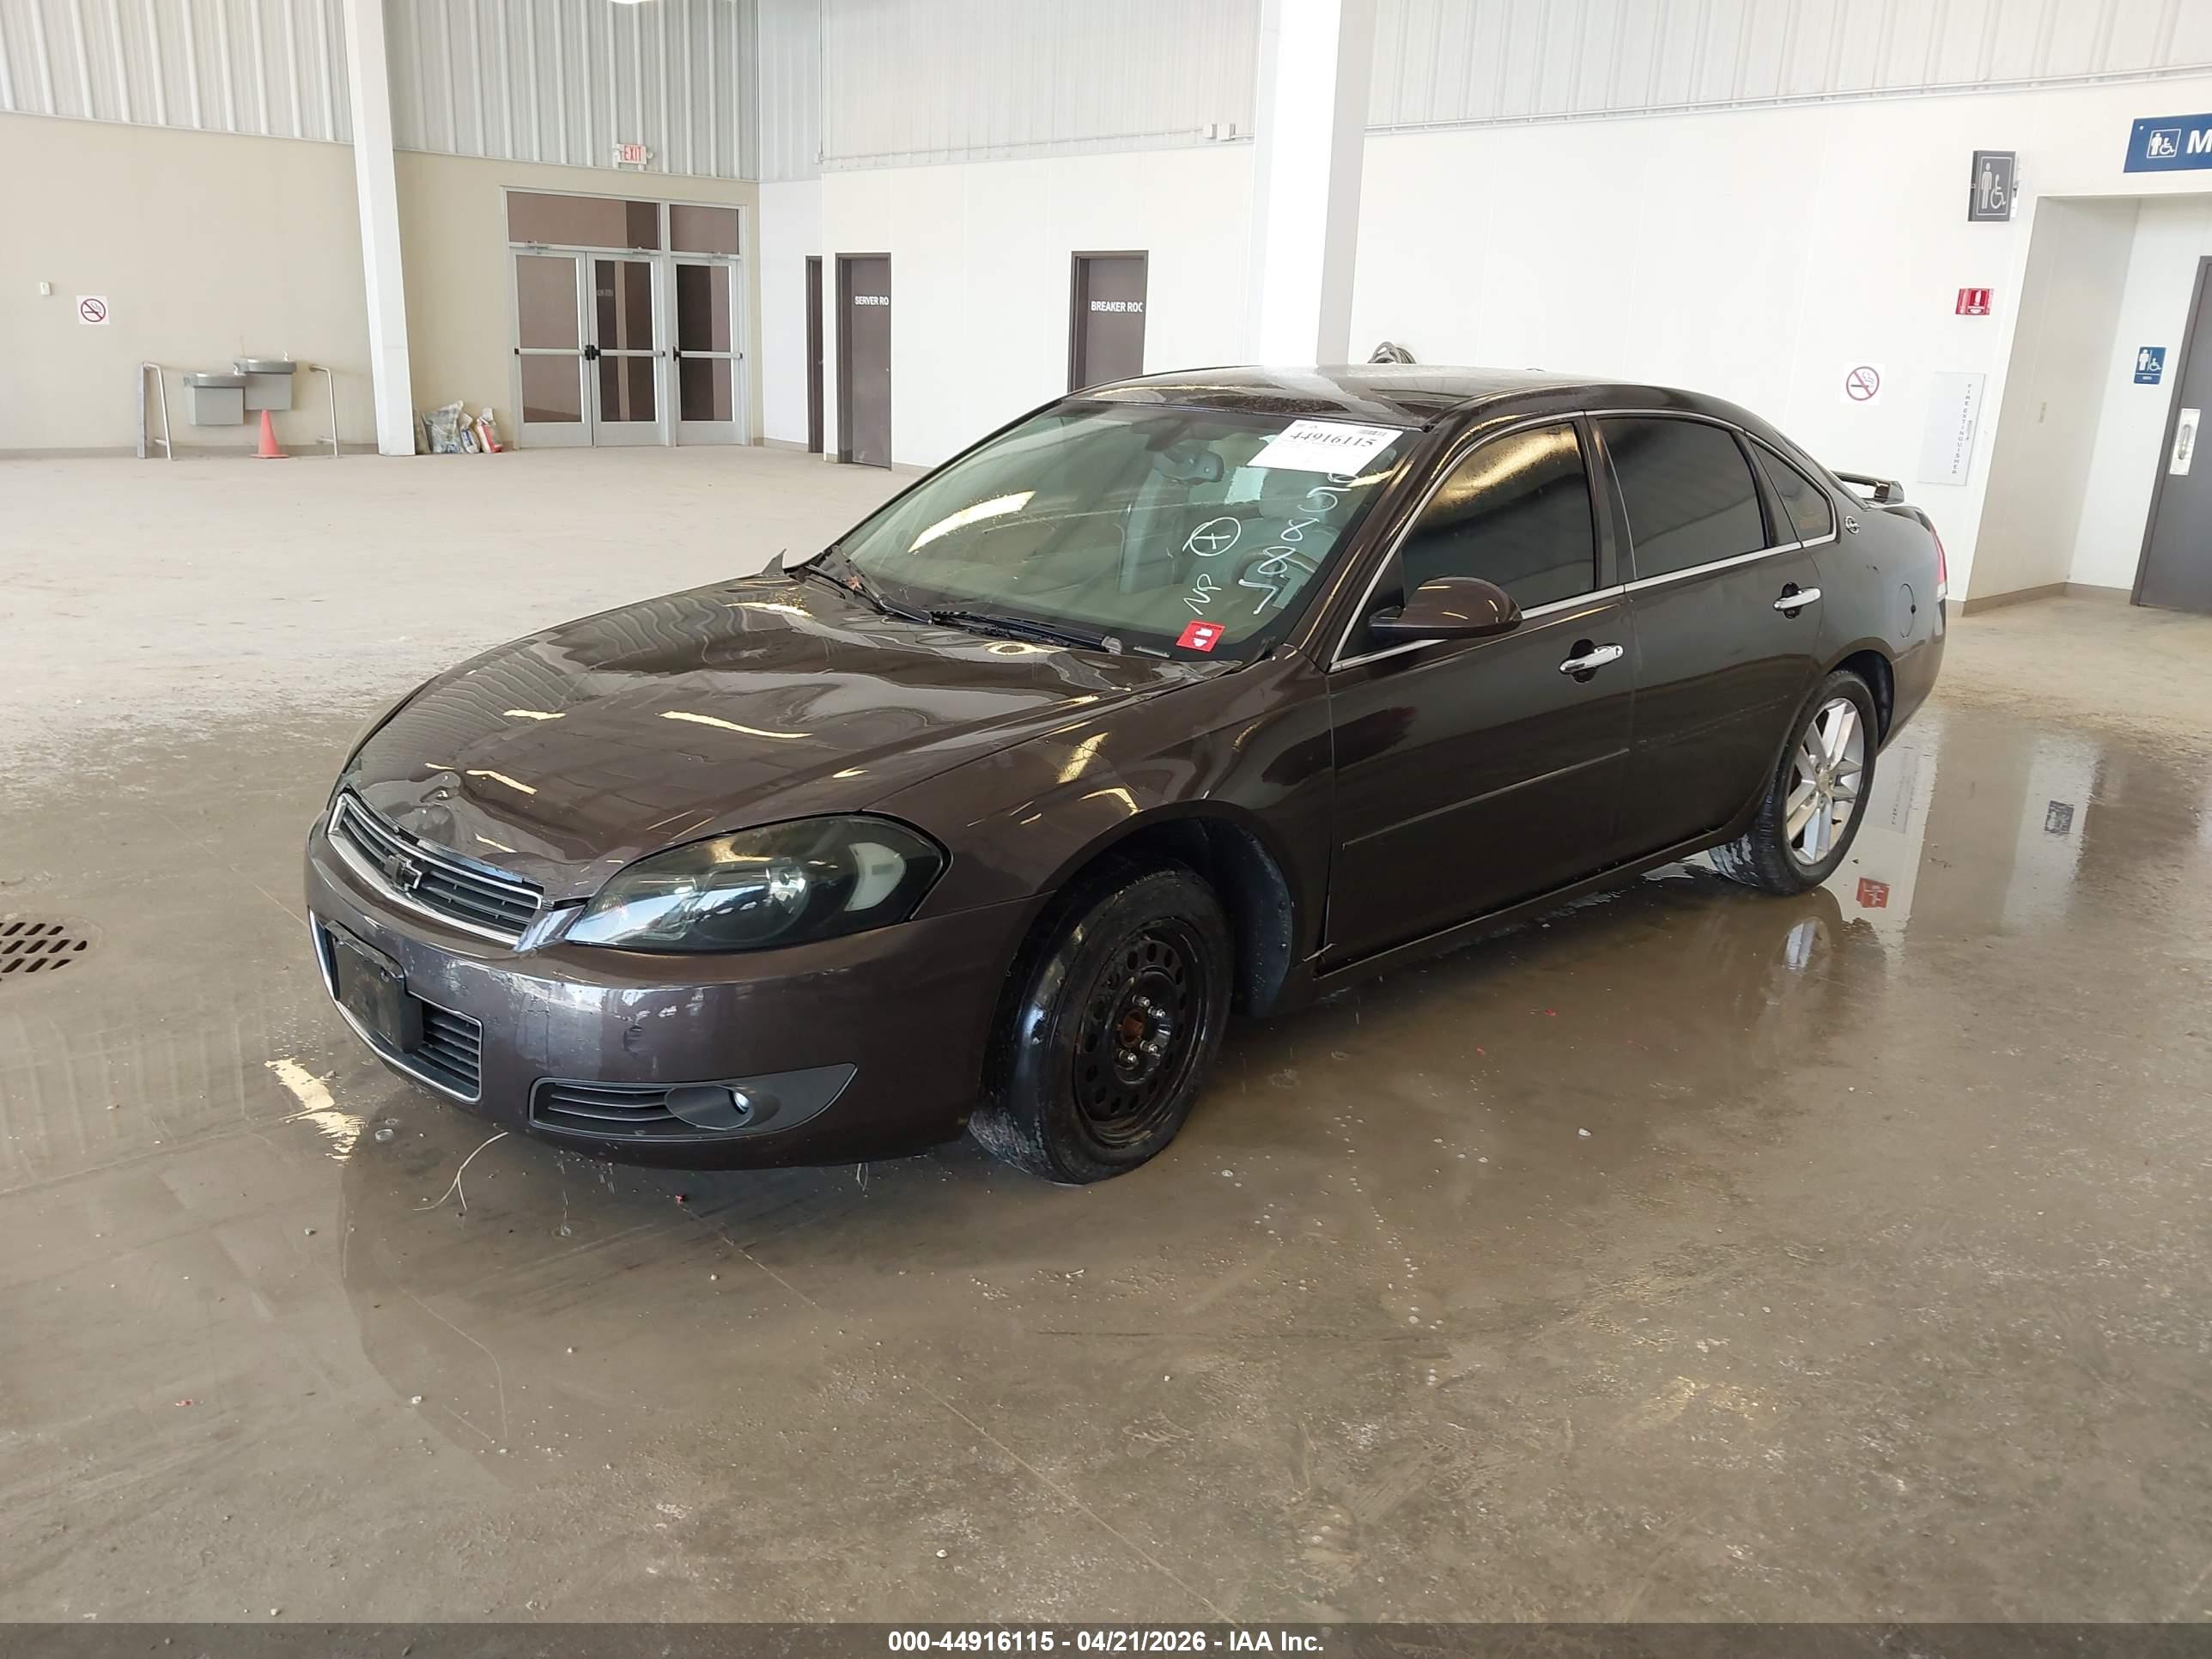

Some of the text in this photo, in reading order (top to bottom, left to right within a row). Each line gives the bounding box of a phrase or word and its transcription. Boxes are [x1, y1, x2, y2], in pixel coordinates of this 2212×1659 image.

[623, 144, 642, 161] EXIT
[854, 295, 890, 306] SERVER RO
[1091, 301, 1126, 312] BREAKER
[1290, 431, 1378, 447] 44916115
